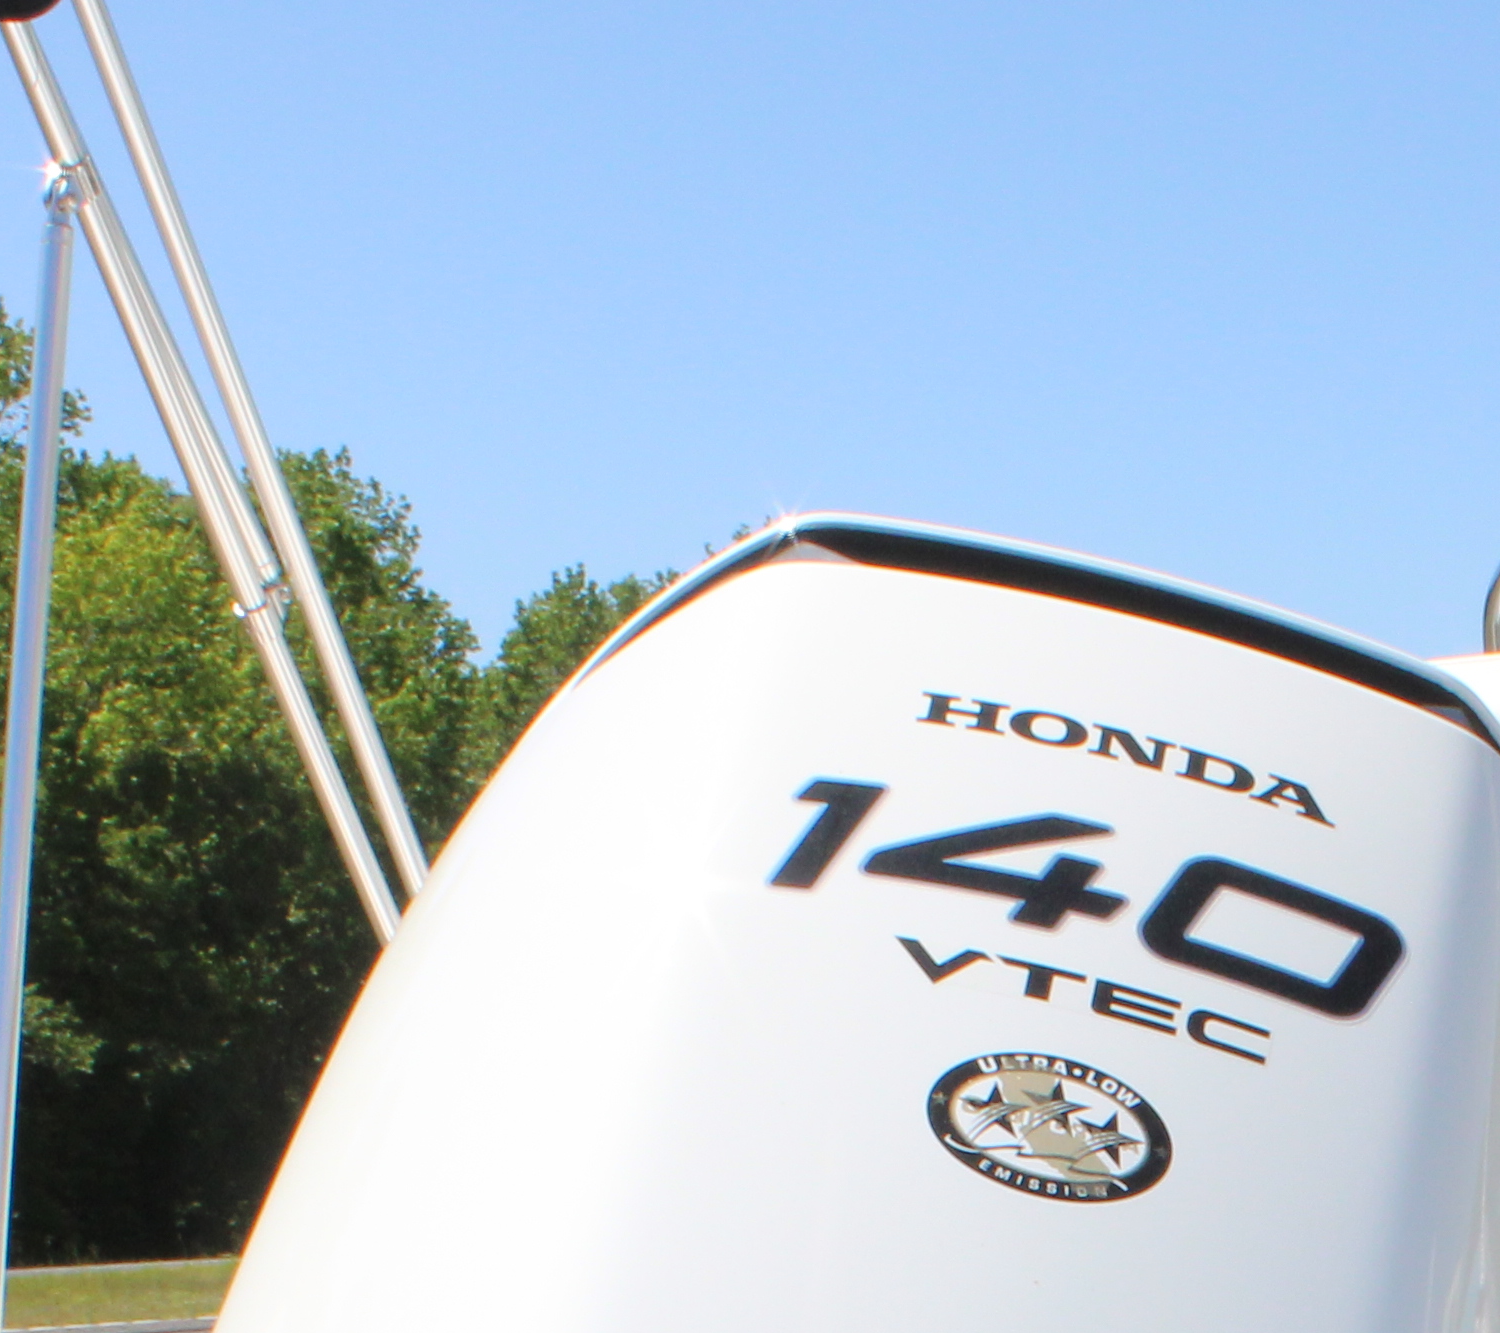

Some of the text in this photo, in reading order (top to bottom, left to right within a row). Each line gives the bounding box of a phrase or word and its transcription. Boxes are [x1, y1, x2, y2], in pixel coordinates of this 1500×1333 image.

[916, 690, 1335, 828] HONDA
[766, 775, 1407, 1024] 140
[895, 936, 1271, 1066] VTEC
[977, 1158, 1108, 1199] EMISSION
